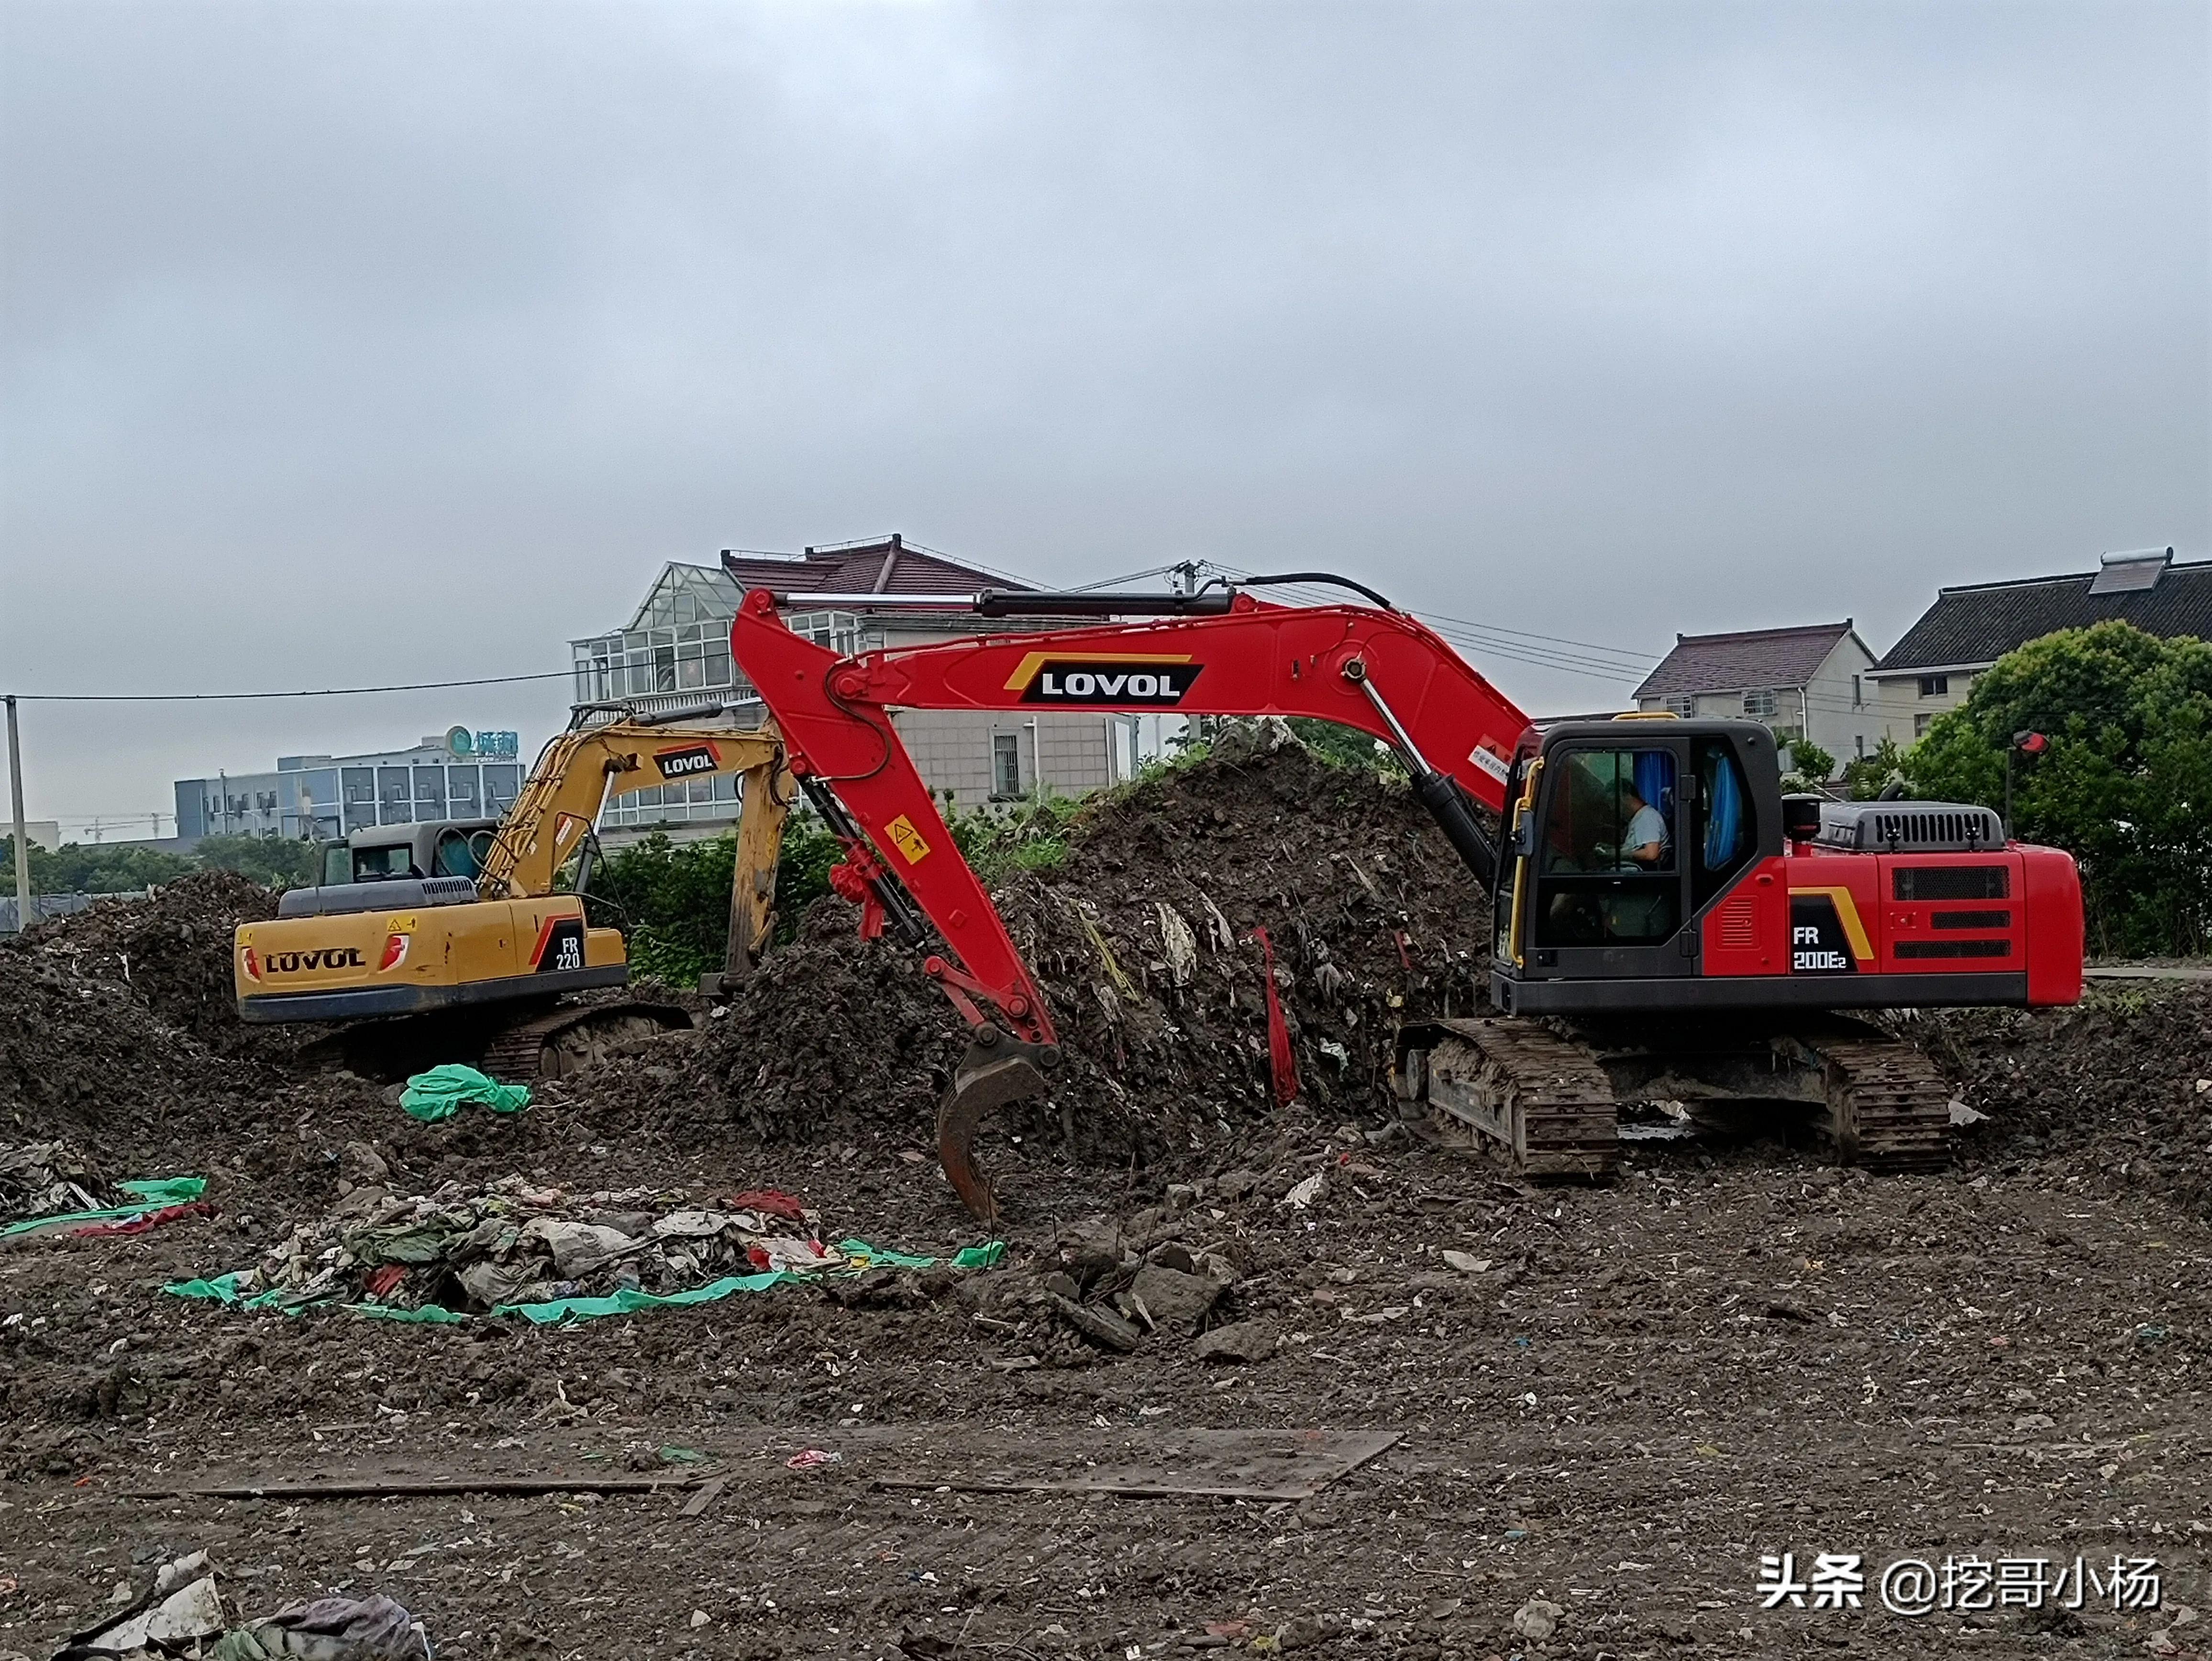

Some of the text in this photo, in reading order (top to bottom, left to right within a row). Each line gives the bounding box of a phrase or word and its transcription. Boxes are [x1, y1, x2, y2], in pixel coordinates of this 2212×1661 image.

[1042, 673, 1180, 697] LOVOL
[664, 754, 713, 775] LOVOL
[562, 937, 578, 953] FR
[1793, 927, 1819, 945] FR
[265, 947, 366, 973] LOVOL
[556, 952, 580, 970] 220
[1793, 951, 1847, 970] 200E2
